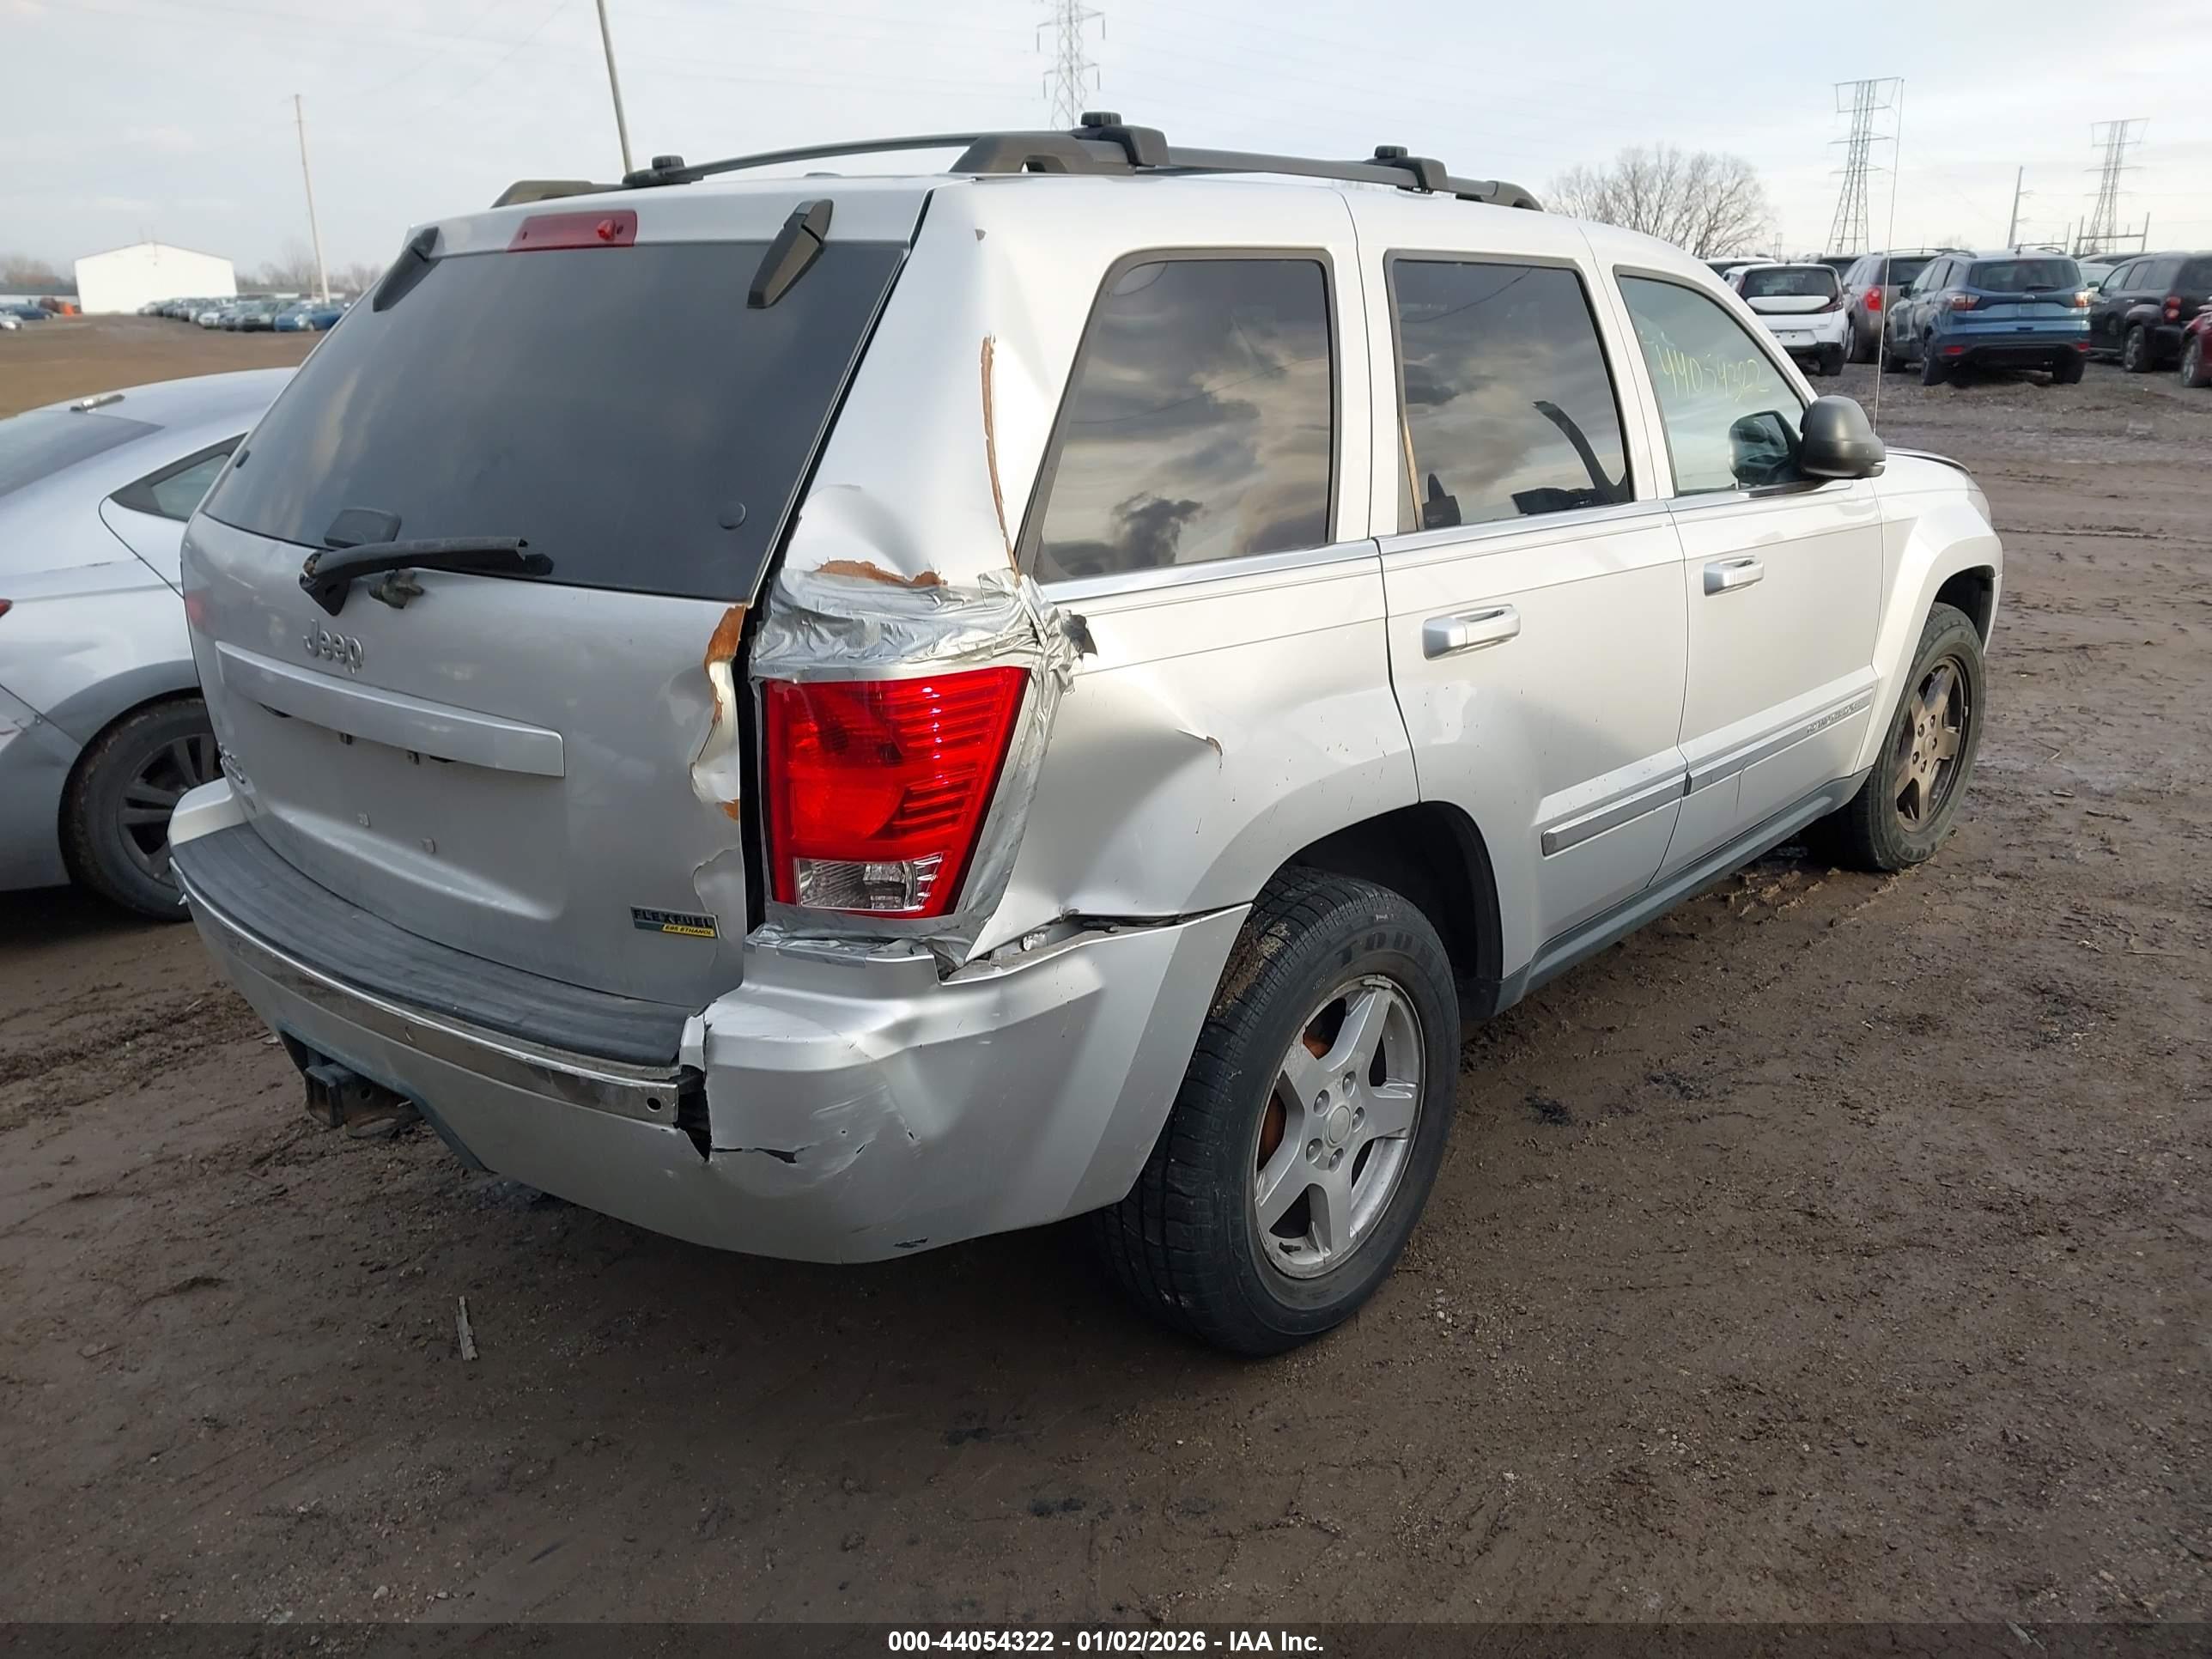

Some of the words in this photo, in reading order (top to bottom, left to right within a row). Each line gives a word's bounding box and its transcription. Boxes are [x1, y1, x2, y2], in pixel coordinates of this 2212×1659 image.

[303, 618, 364, 674] Jeep
[634, 909, 714, 928] FLEXFUEL
[680, 926, 713, 936] ETHANOL
